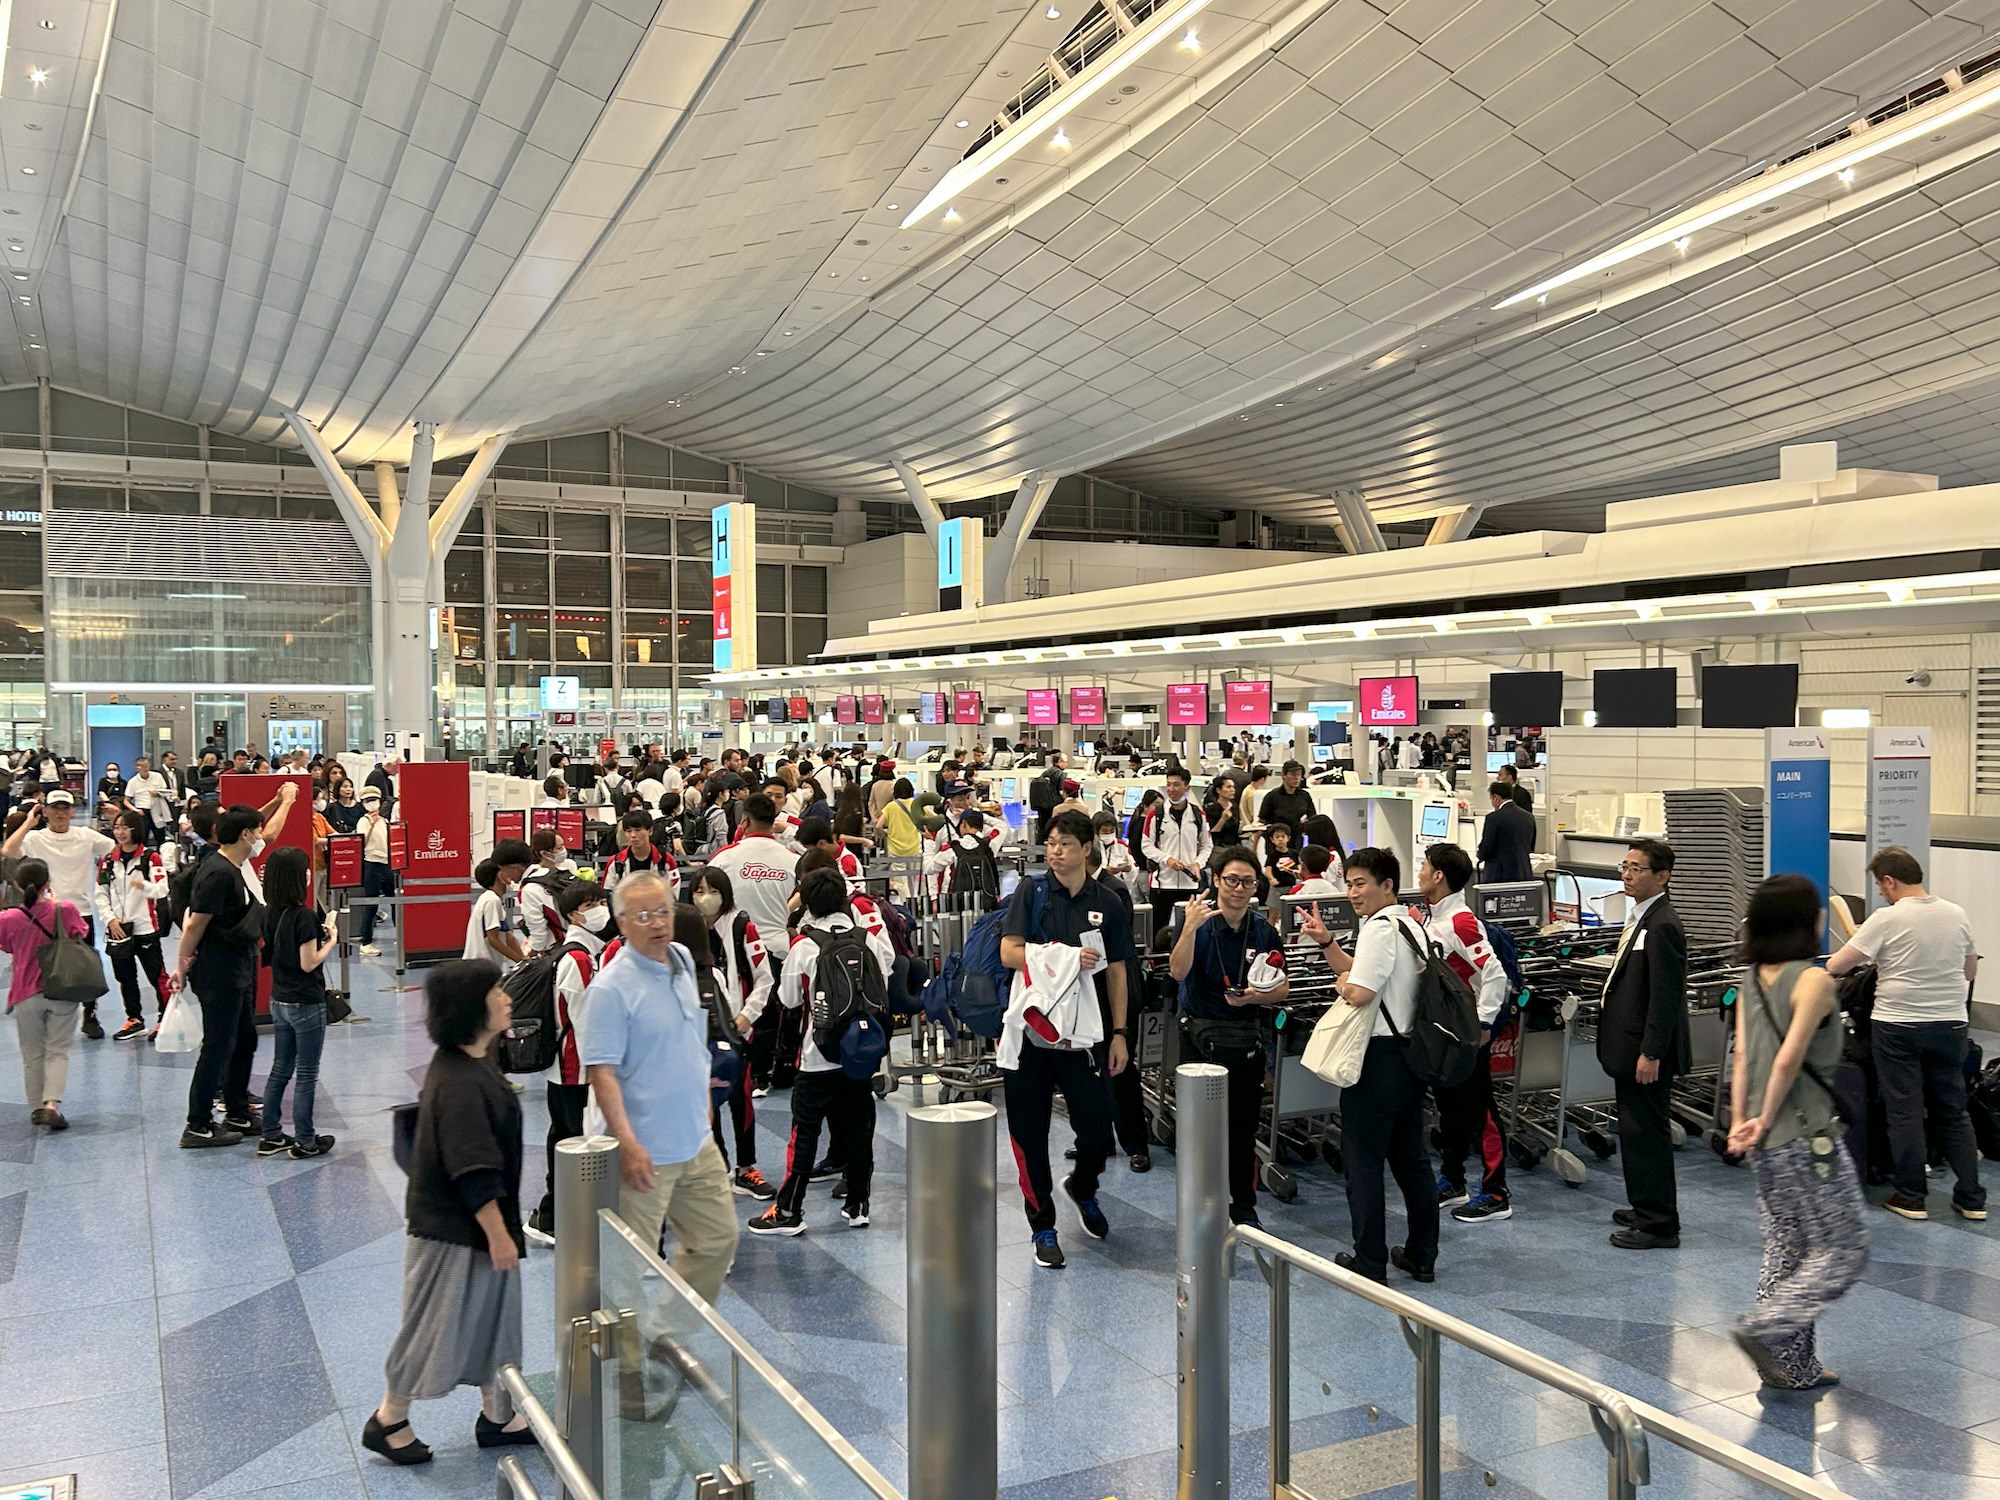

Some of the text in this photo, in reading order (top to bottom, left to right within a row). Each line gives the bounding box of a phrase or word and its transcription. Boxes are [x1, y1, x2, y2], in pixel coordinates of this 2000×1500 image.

[717, 518, 728, 560] H
[558, 681, 566, 694] Z
[1371, 709, 1405, 719] Emirates
[386, 735, 394, 746] 2
[1788, 739, 1815, 747] American
[1776, 772, 1801, 781] MAIN
[1879, 771, 1919, 780] PRIORITY
[414, 850, 458, 859] Emirates
[741, 862, 788, 883] Japan
